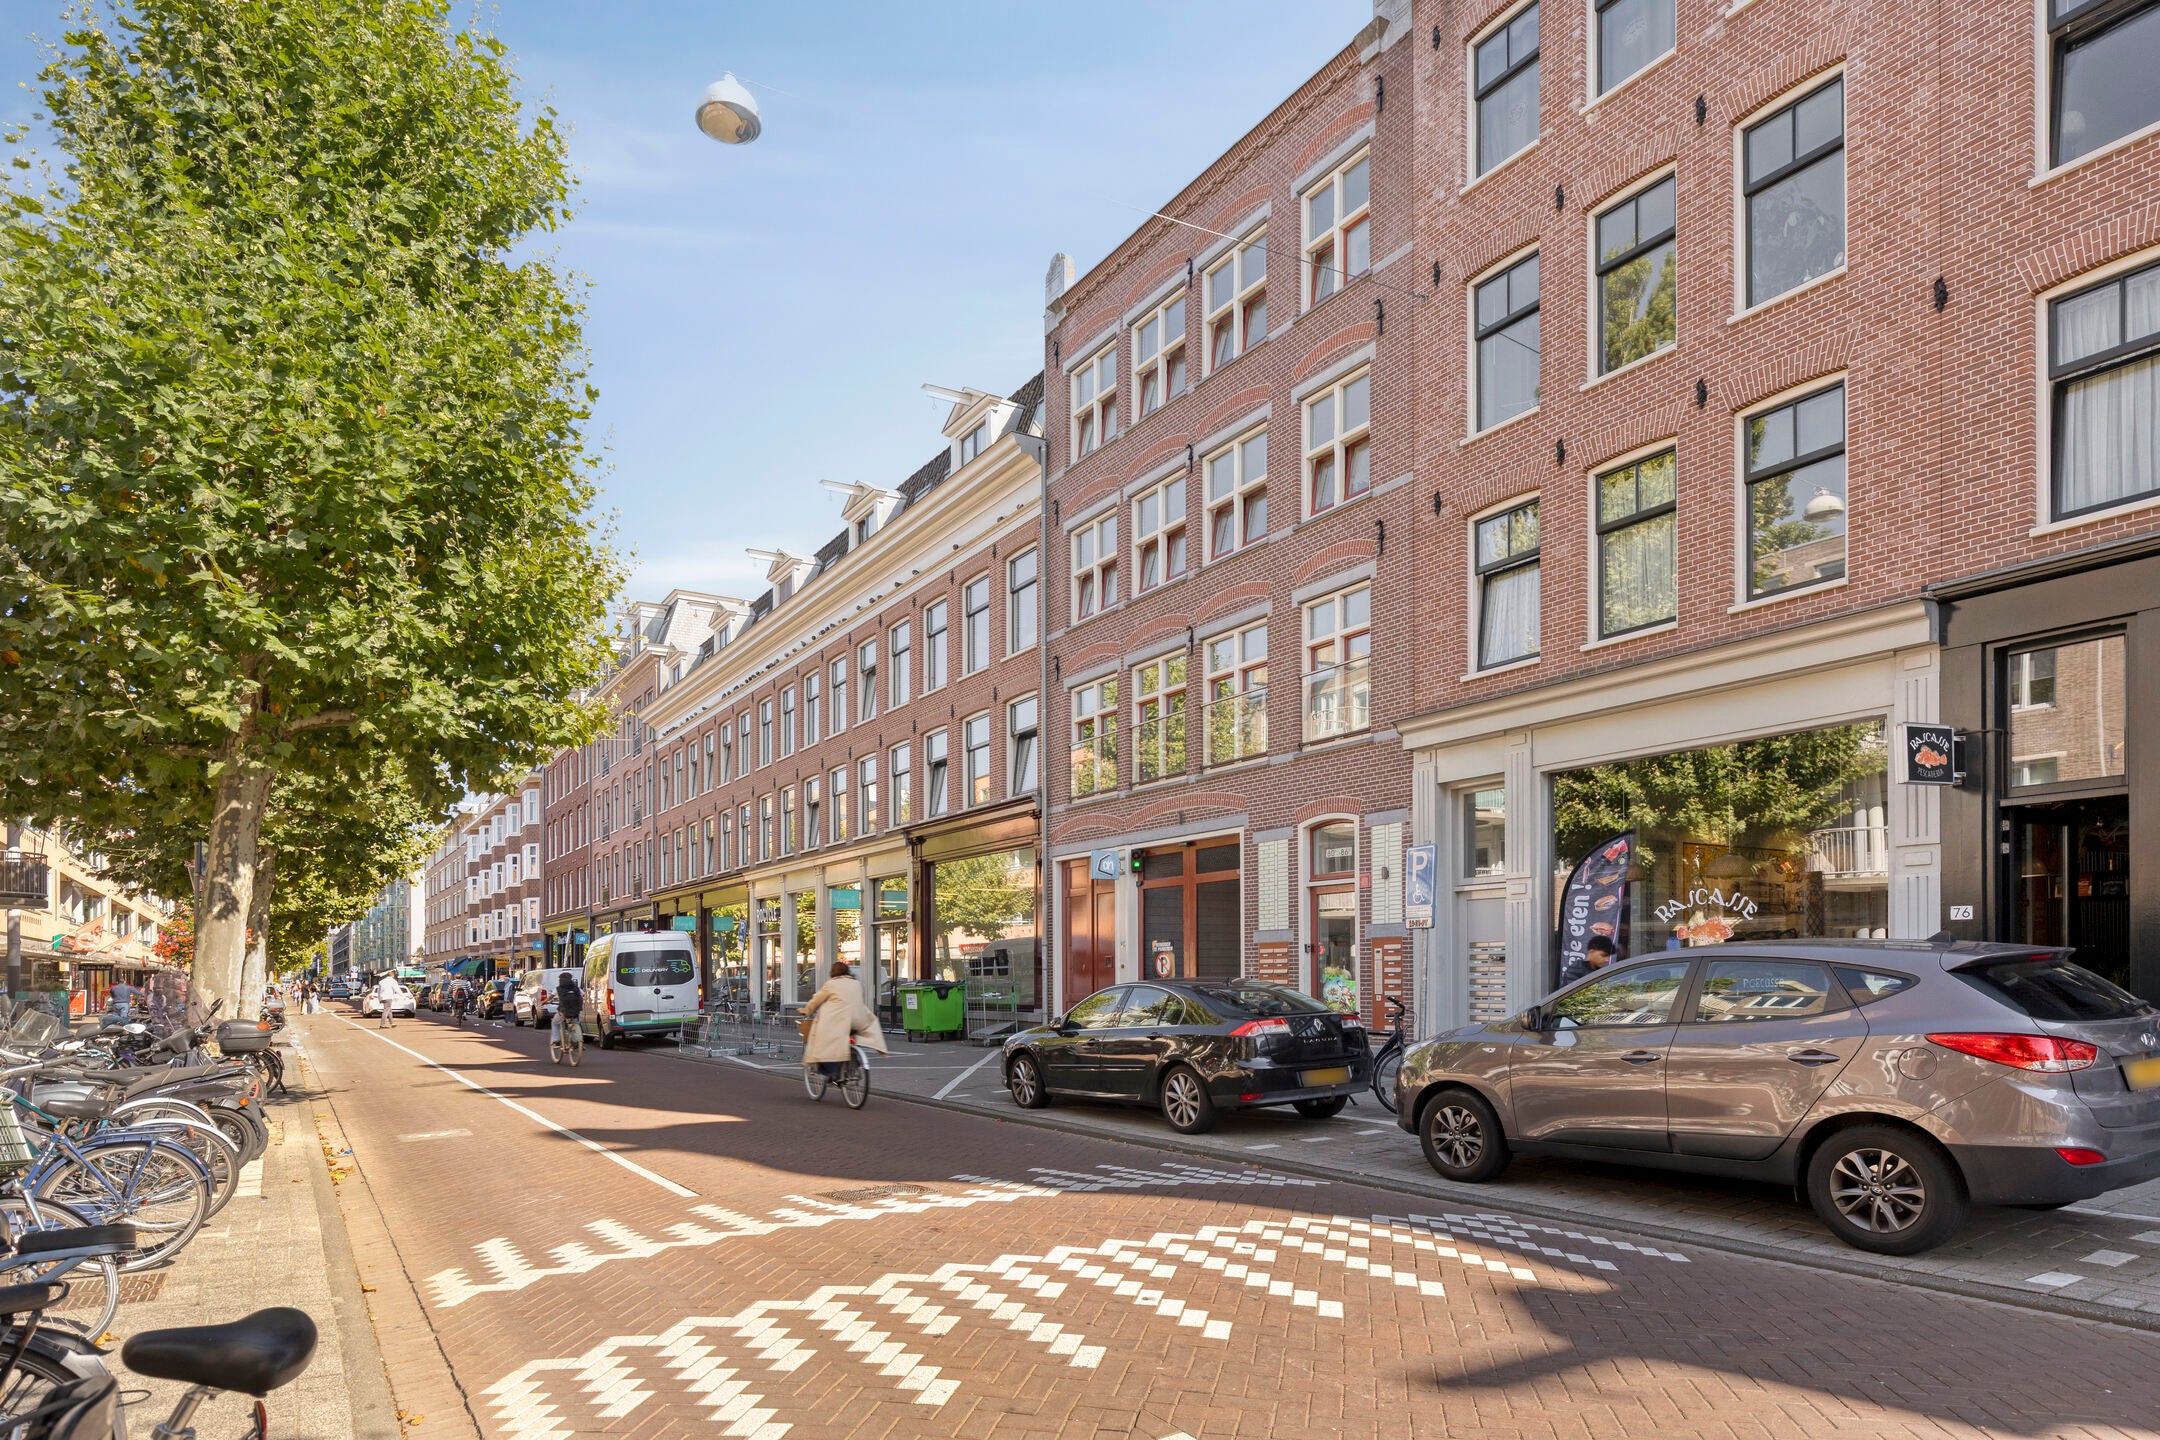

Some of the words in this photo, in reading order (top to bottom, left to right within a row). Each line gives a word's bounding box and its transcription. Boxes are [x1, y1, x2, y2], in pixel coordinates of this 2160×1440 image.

[1909, 732, 1950, 752] RASCASSE
[1411, 851, 1428, 882] P
[1567, 895, 1590, 936] eten
[1653, 887, 1759, 924] RASCASSE
[1953, 907, 1970, 918] 76
